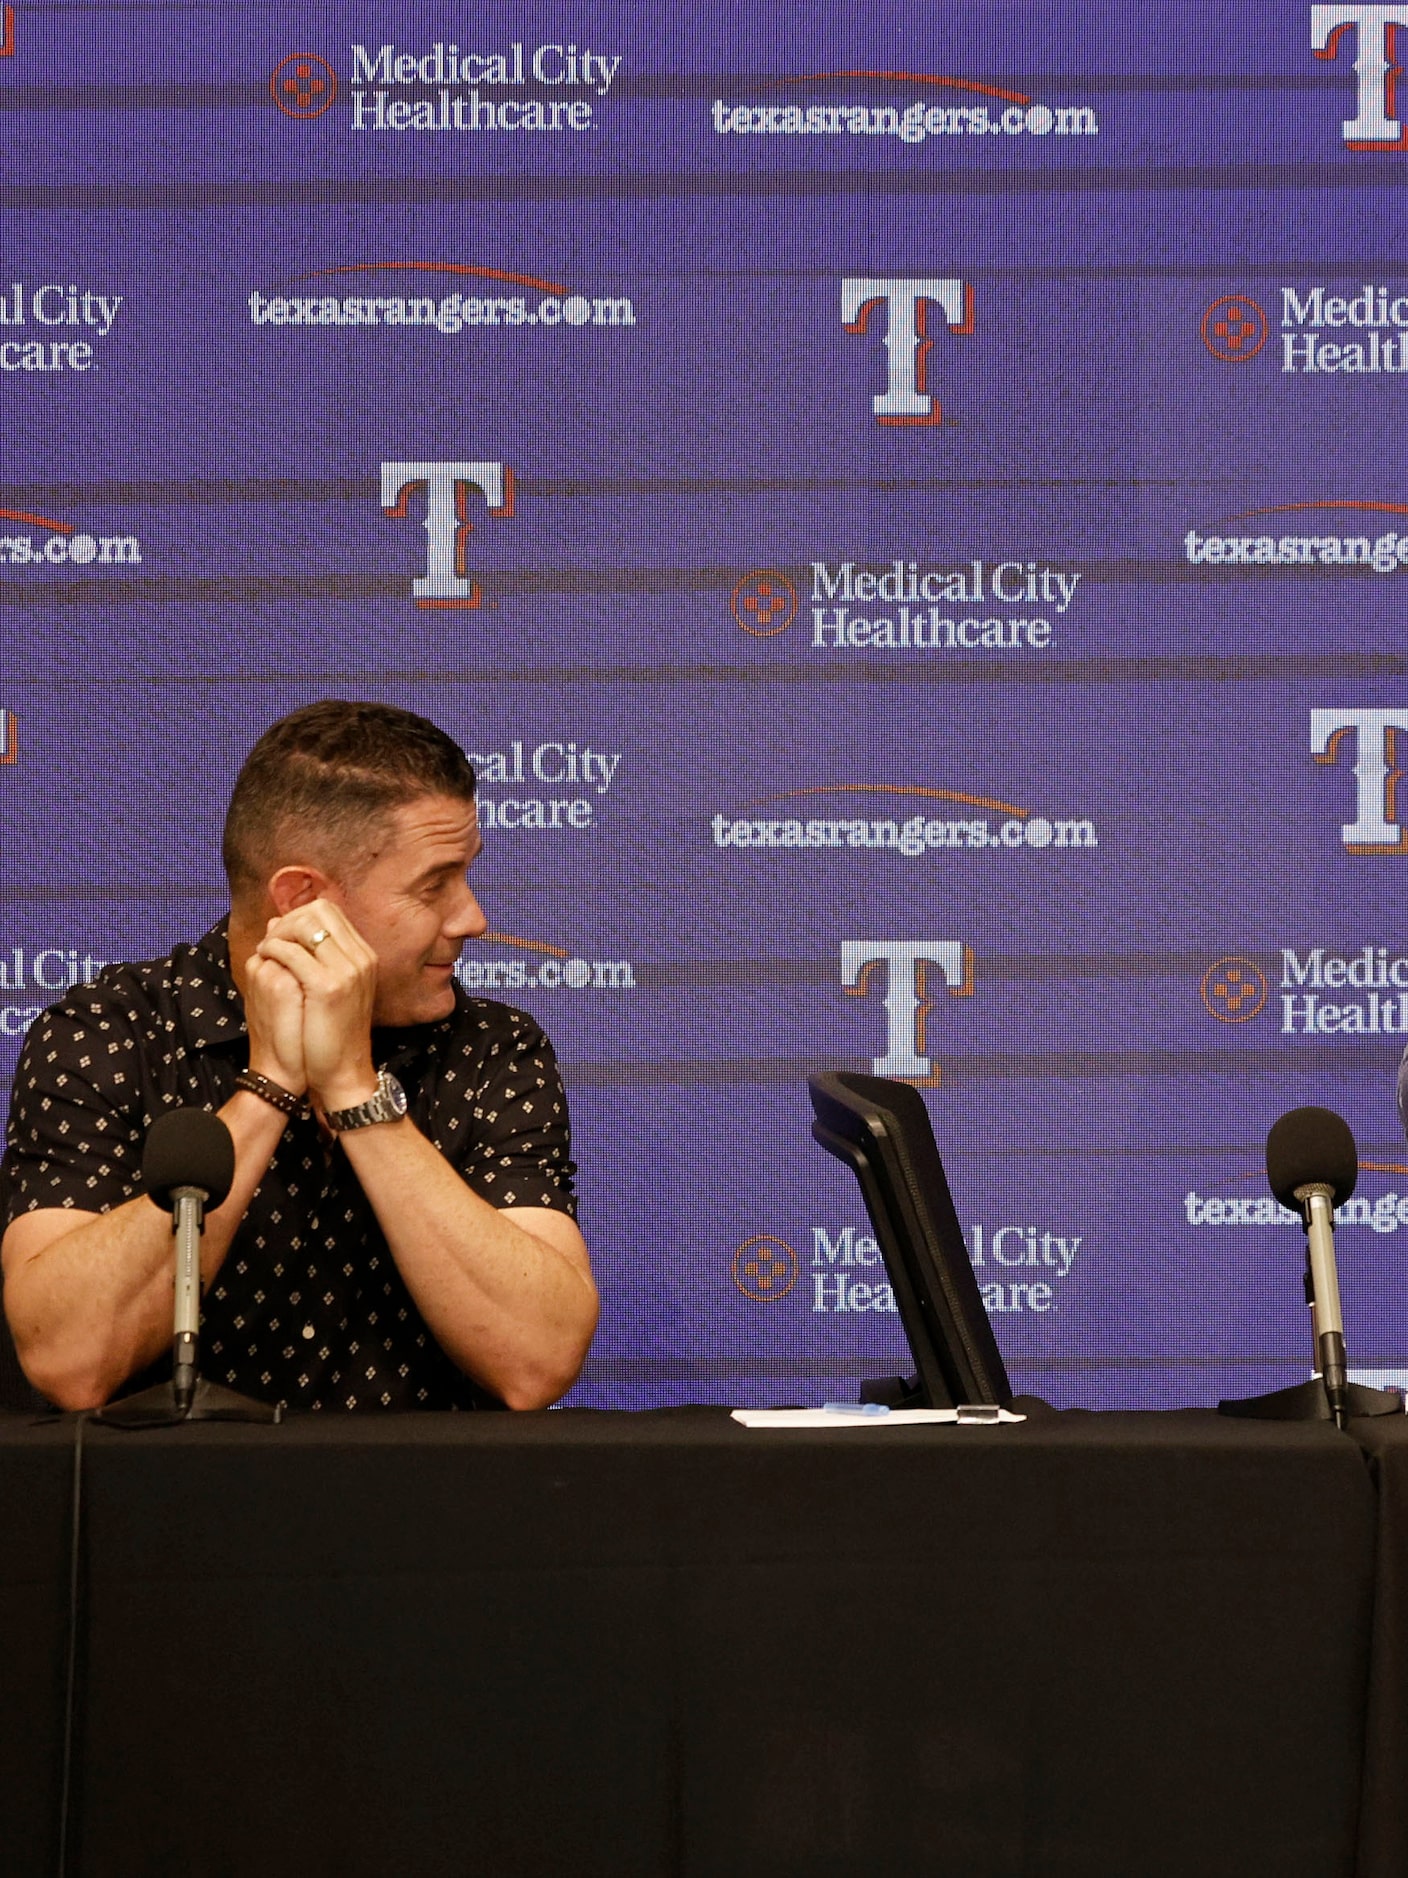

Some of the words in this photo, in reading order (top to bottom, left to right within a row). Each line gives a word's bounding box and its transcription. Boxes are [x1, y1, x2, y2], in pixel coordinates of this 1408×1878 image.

[352, 43, 524, 83] Medical
[533, 45, 622, 95] City
[352, 90, 592, 131] Healthcare
[712, 100, 1098, 142] texasrangers.com
[33, 285, 122, 335] City
[248, 292, 636, 333] texasrangers.com
[841, 279, 973, 426] T
[381, 462, 513, 609] T
[811, 561, 984, 601] Medical
[992, 563, 1081, 612] City
[812, 607, 1050, 649] Healthcare
[533, 743, 621, 793] City
[711, 814, 1098, 856] texasrangers.com
[33, 949, 123, 989] Cit
[841, 941, 974, 1087] T
[993, 1227, 1082, 1276] City
